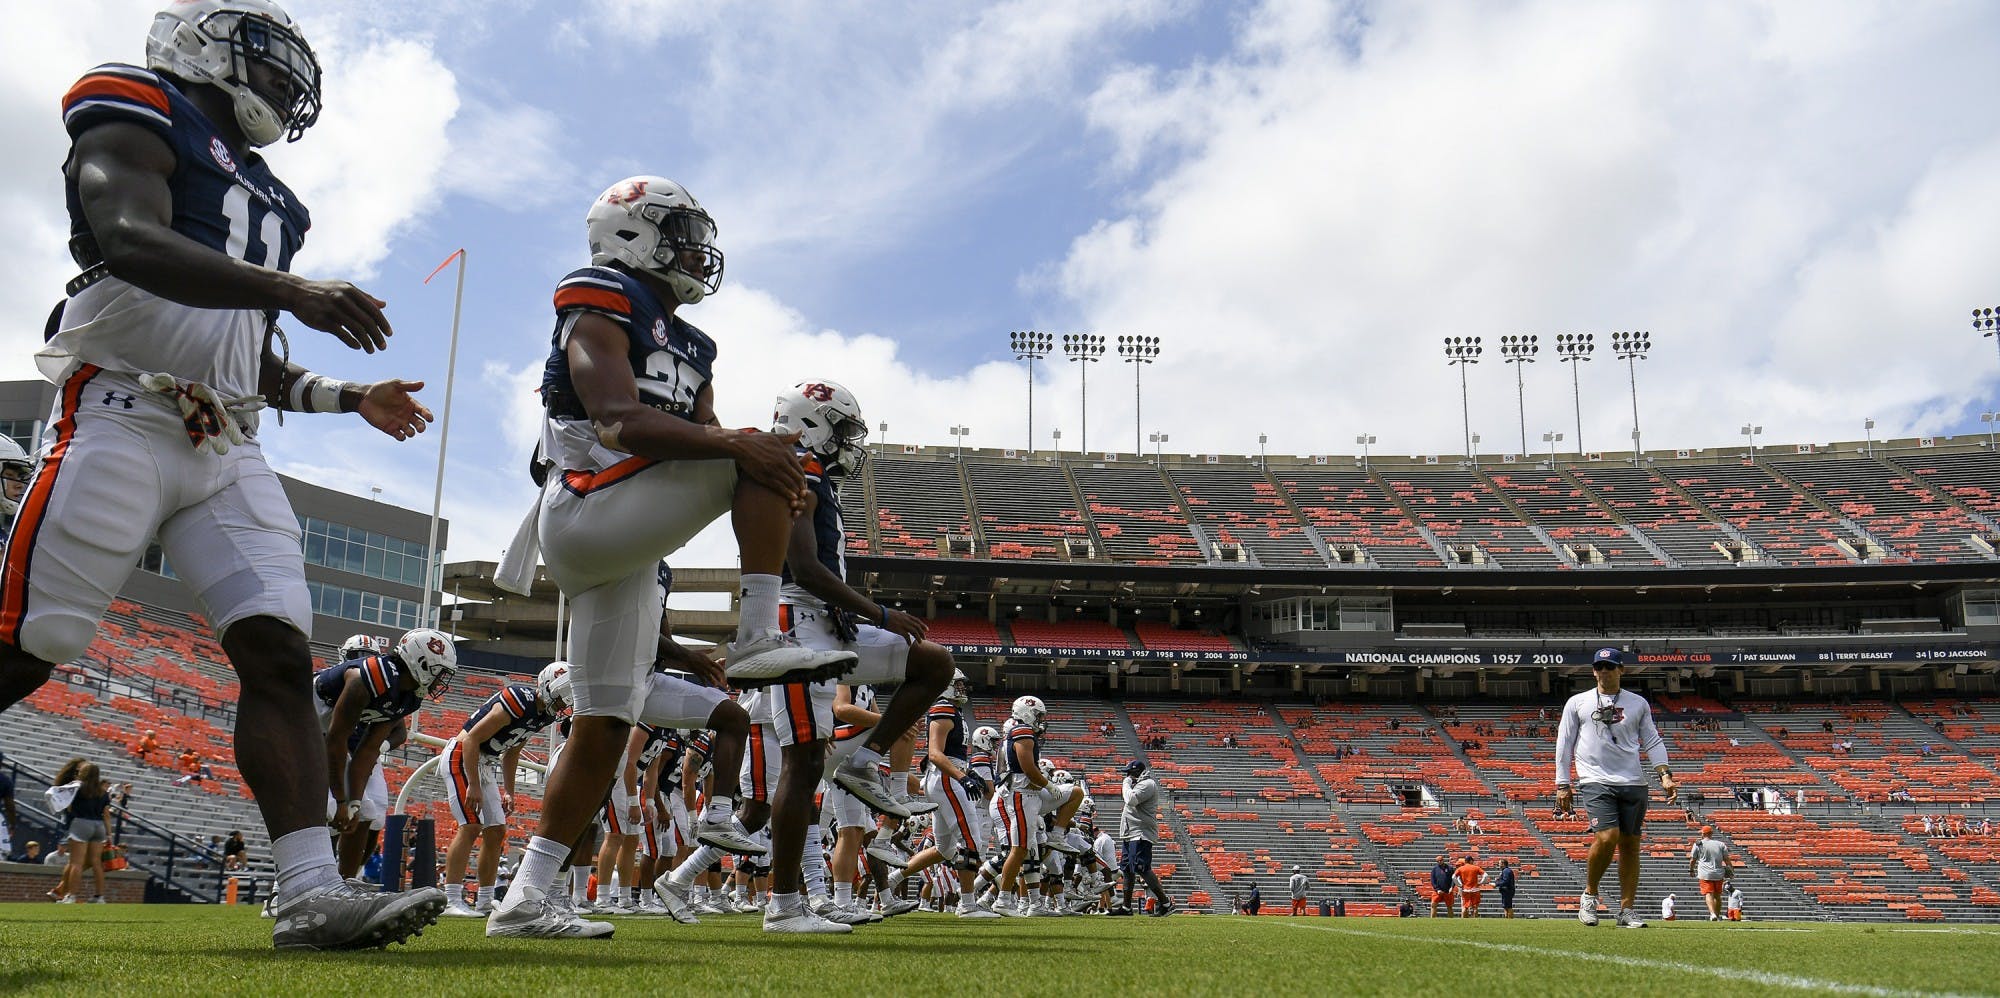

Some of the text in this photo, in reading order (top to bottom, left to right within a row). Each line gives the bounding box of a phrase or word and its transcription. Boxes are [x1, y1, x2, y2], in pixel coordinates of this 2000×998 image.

[235, 171, 272, 206] AUBURN
[222, 183, 284, 271] 11
[960, 645, 978, 653] 1893
[1059, 648, 1076, 656] 1913
[1107, 649, 1125, 657] 1932
[1947, 650, 1987, 658] JACKSON
[1345, 653, 1564, 664] NATIONAL CHAMPIONS 1957 2010
[1638, 654, 1712, 663] BROADWAY CLUB
[1759, 653, 1796, 661] SULLIVAN
[520, 687, 535, 702] 32
